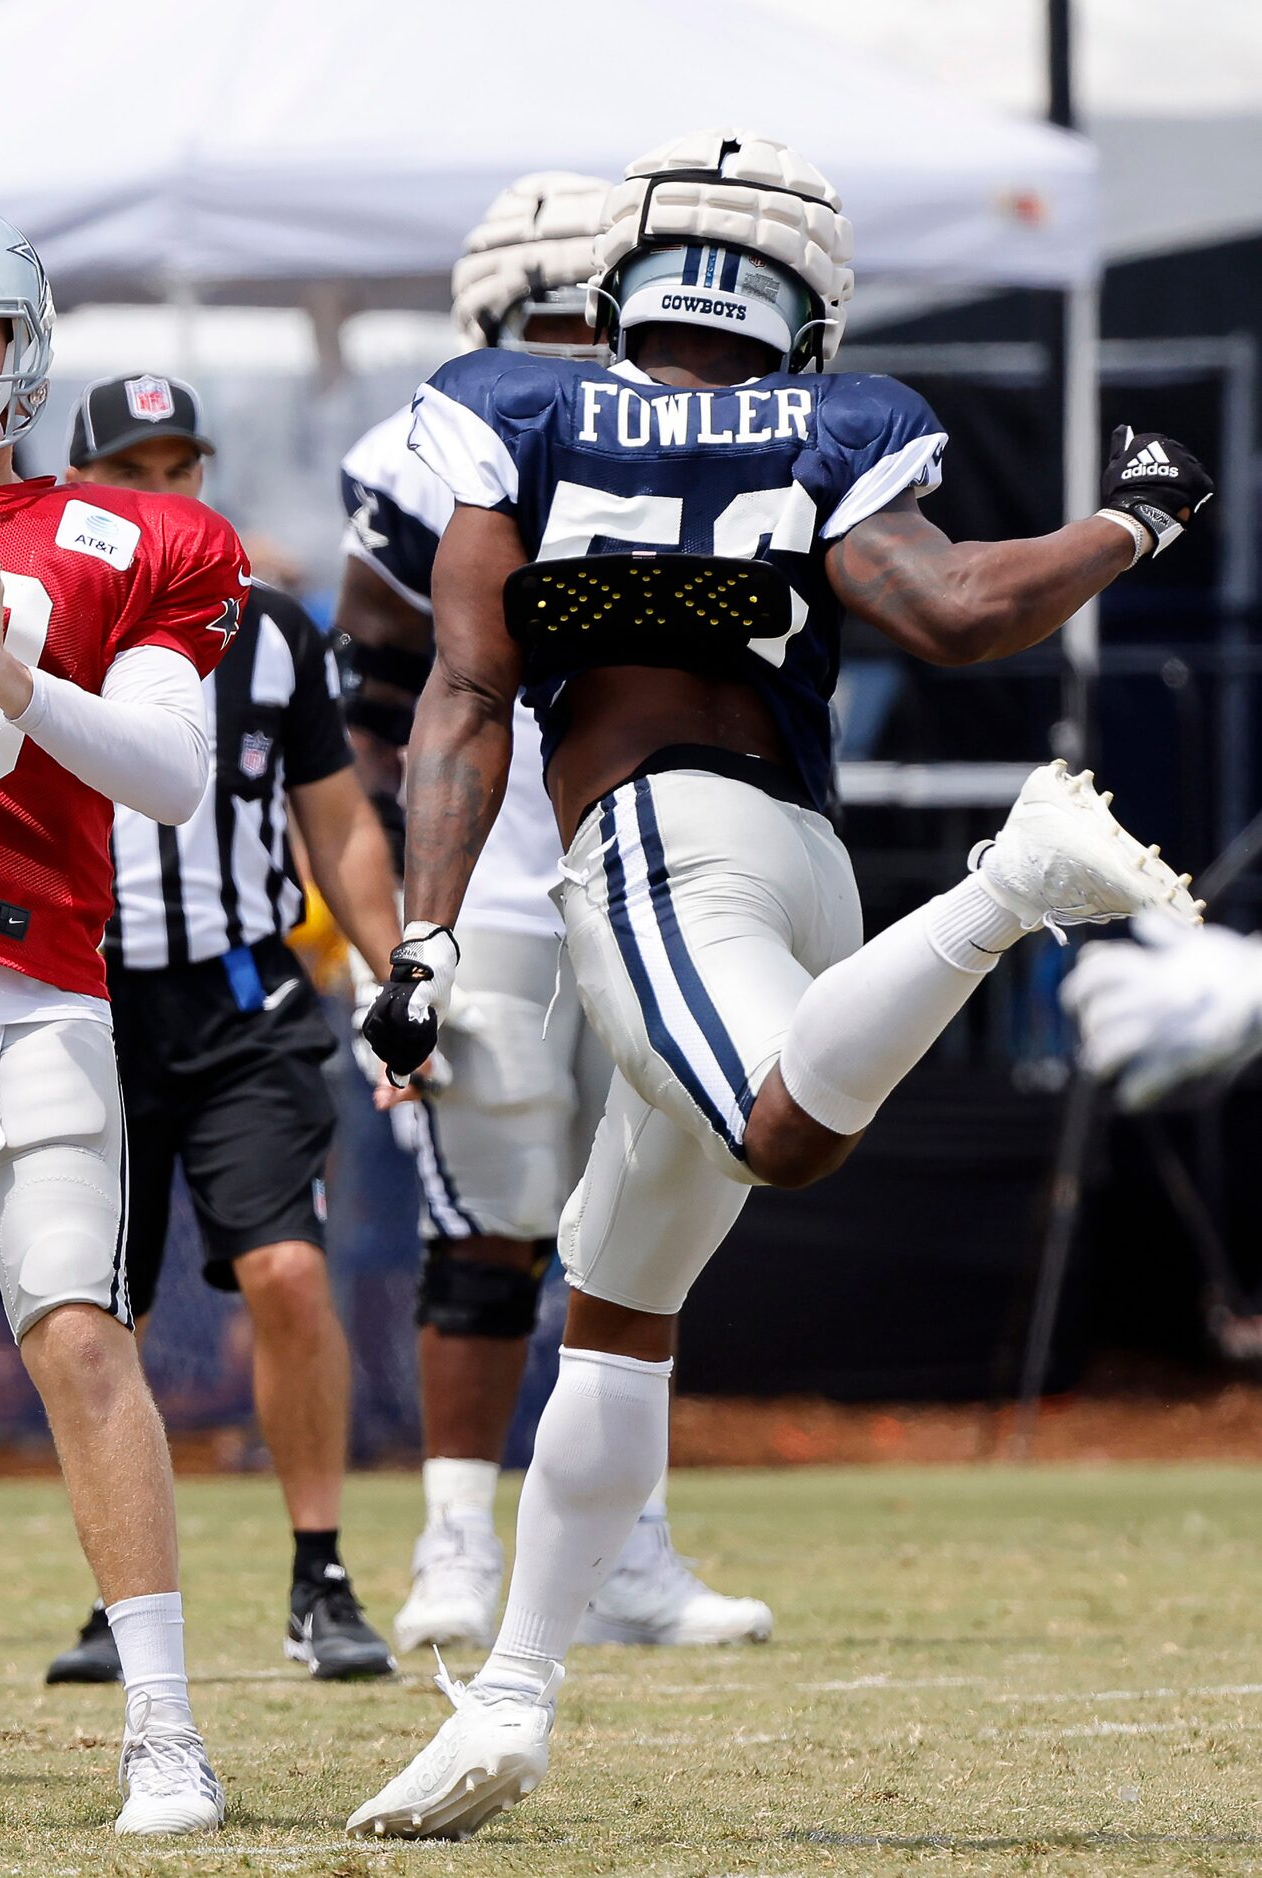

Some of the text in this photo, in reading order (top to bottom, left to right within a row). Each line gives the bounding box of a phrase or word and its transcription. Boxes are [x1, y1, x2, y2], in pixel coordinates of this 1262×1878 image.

[662, 295, 747, 321] COWBOYS
[578, 381, 812, 447] FOWLER
[1120, 463, 1179, 480] adidas
[74, 533, 118, 555] AT&T
